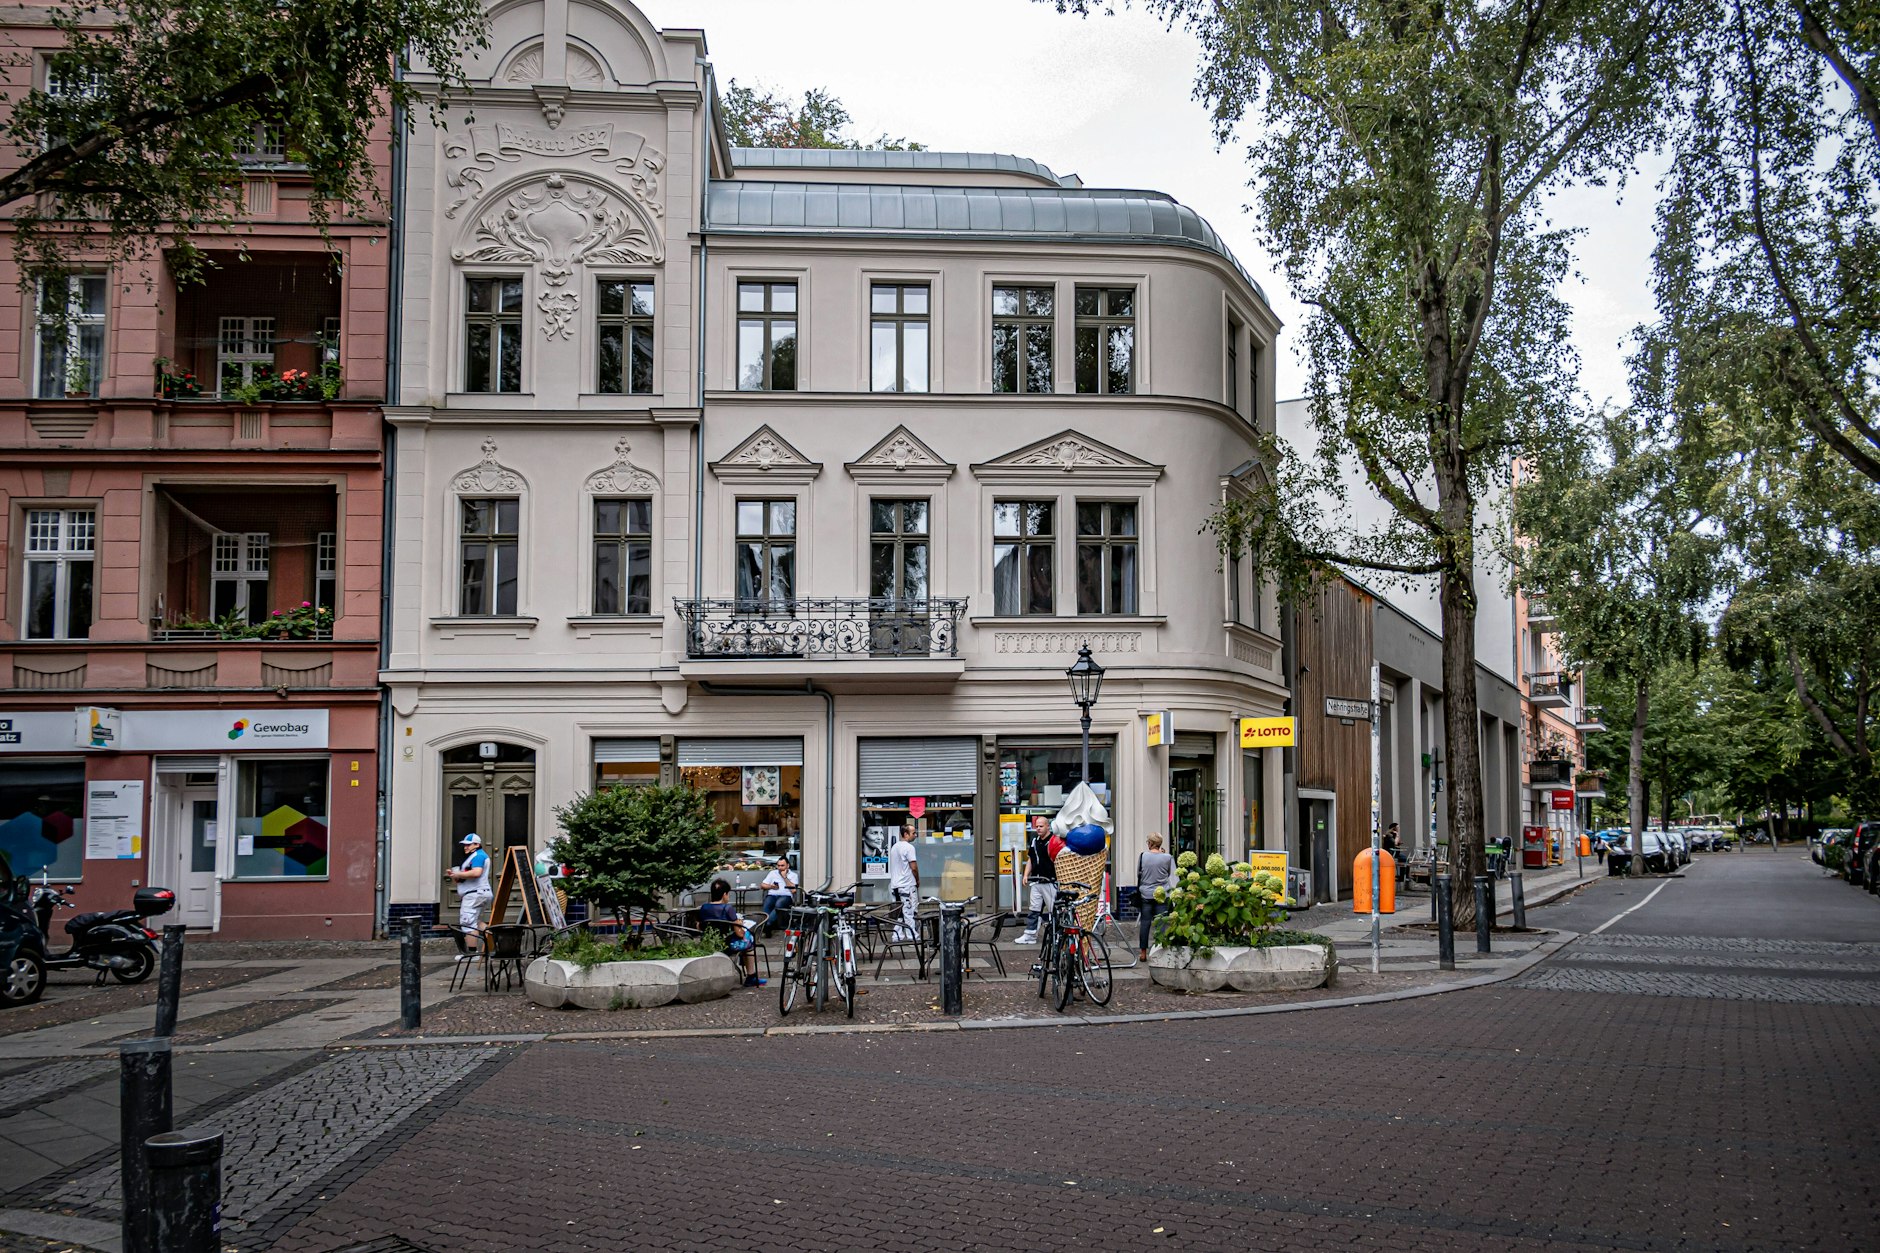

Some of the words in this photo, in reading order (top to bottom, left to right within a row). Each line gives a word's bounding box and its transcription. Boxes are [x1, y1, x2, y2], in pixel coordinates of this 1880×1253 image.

[500, 126, 566, 152] Erbaut
[570, 130, 607, 150] 1897
[1328, 701, 1368, 715] Nehringstraße
[253, 722, 309, 734] Gewobag
[1258, 727, 1291, 737] LOTTO
[484, 745, 489, 754] 1
